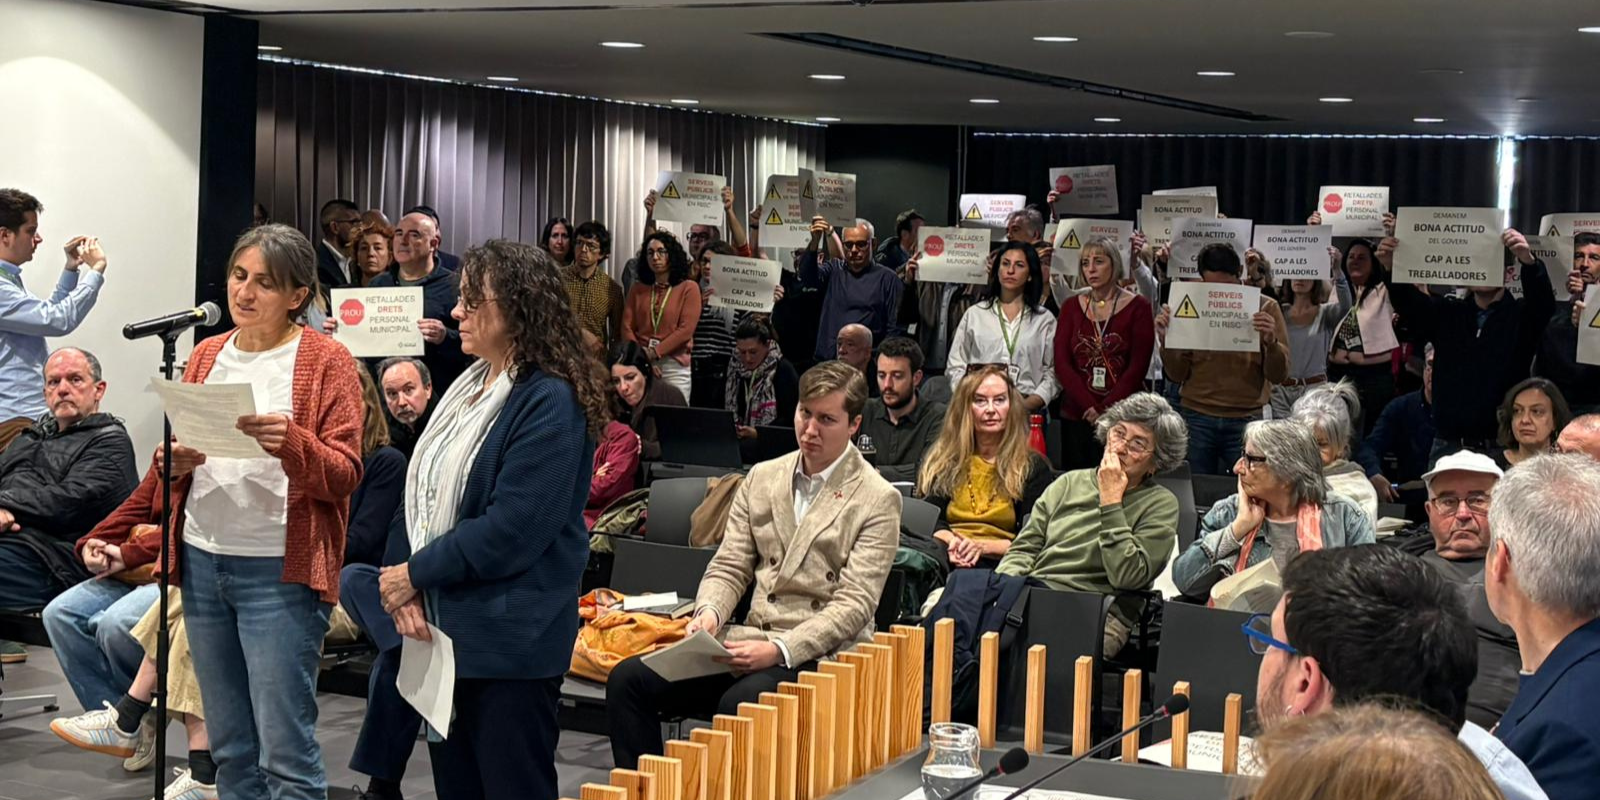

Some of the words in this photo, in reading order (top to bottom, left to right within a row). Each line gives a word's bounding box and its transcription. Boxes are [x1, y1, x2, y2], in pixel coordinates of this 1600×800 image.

[1413, 223, 1441, 232] BONA
[1443, 224, 1485, 234] ACTITUD
[1182, 230, 1203, 238] BONA
[1204, 231, 1236, 239] ACTITUD
[1425, 255, 1443, 263] CAP
[1445, 256, 1452, 264] A
[1455, 256, 1470, 265] LES
[722, 266, 740, 274] BONA
[741, 268, 768, 278] ACTITUD
[1408, 269, 1487, 281] TREBALLADORES
[745, 290, 756, 298] ALS
[1208, 290, 1243, 299] SERVEIS
[366, 295, 416, 303] RETALLADES
[720, 297, 764, 309] TREBALLADORS
[377, 305, 403, 313] DRETS
[1201, 310, 1249, 319] MUNICIPALS
[369, 315, 411, 324] PERSONAL
[1209, 320, 1220, 328] EN
[1221, 320, 1242, 329] RISC
[369, 325, 412, 334] MUNICIPAL
